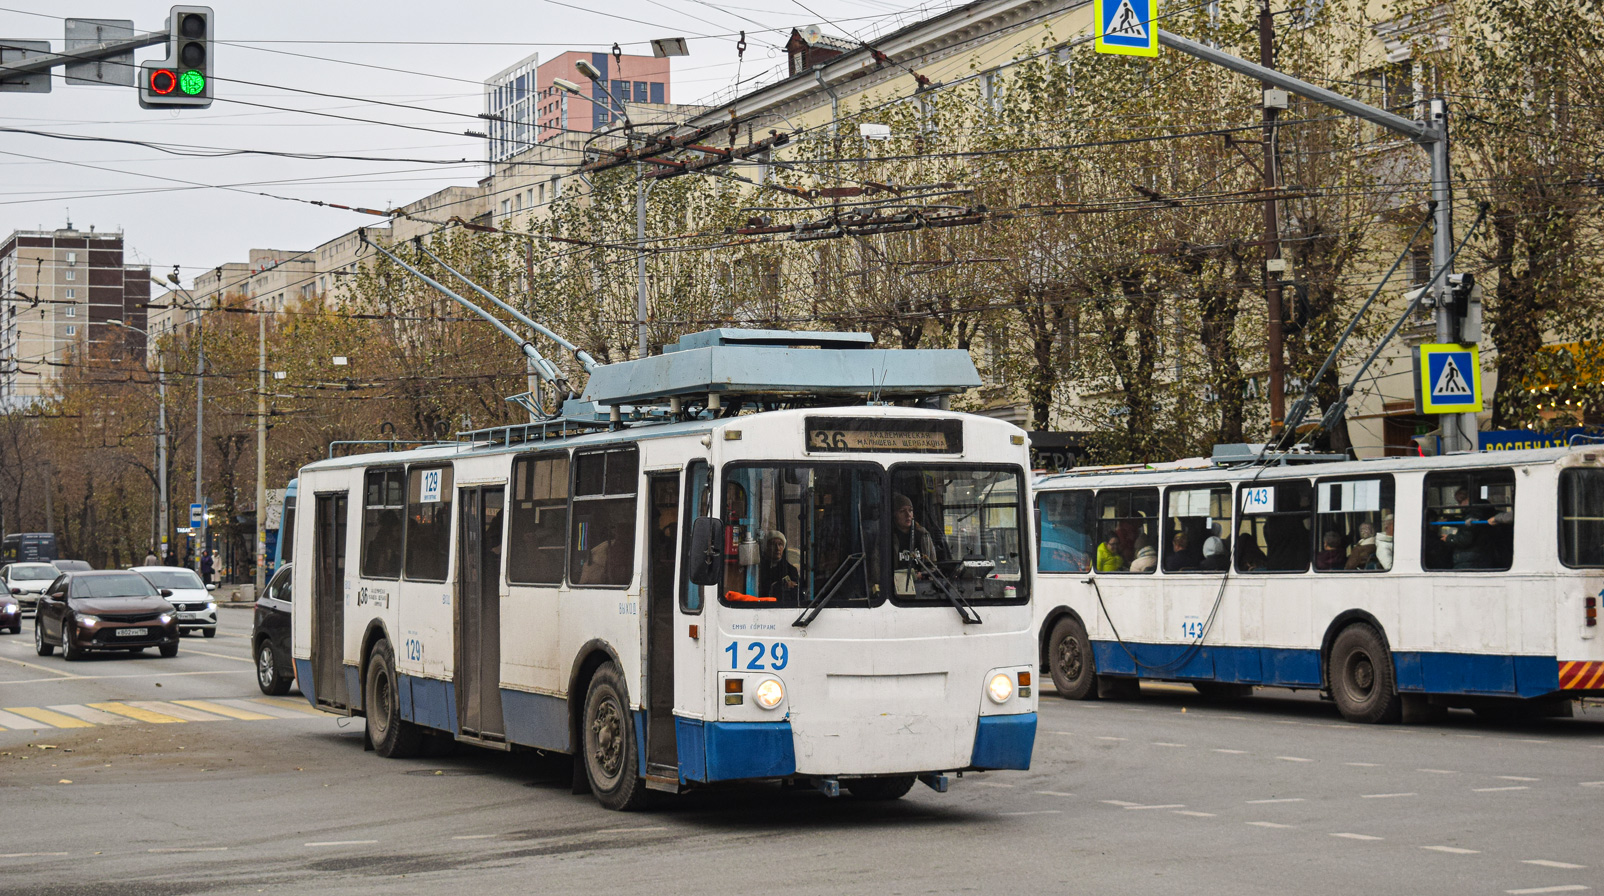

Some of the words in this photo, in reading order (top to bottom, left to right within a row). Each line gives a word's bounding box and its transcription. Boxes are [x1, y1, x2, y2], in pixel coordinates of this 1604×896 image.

[814, 431, 849, 451] 36
[902, 439, 945, 447] ЩЕРБАКОВА
[425, 471, 438, 492] 129
[1248, 489, 1268, 504] 143
[360, 587, 368, 604] 36
[1182, 622, 1203, 638] 143
[406, 639, 420, 661] 129
[725, 641, 789, 670] 129
